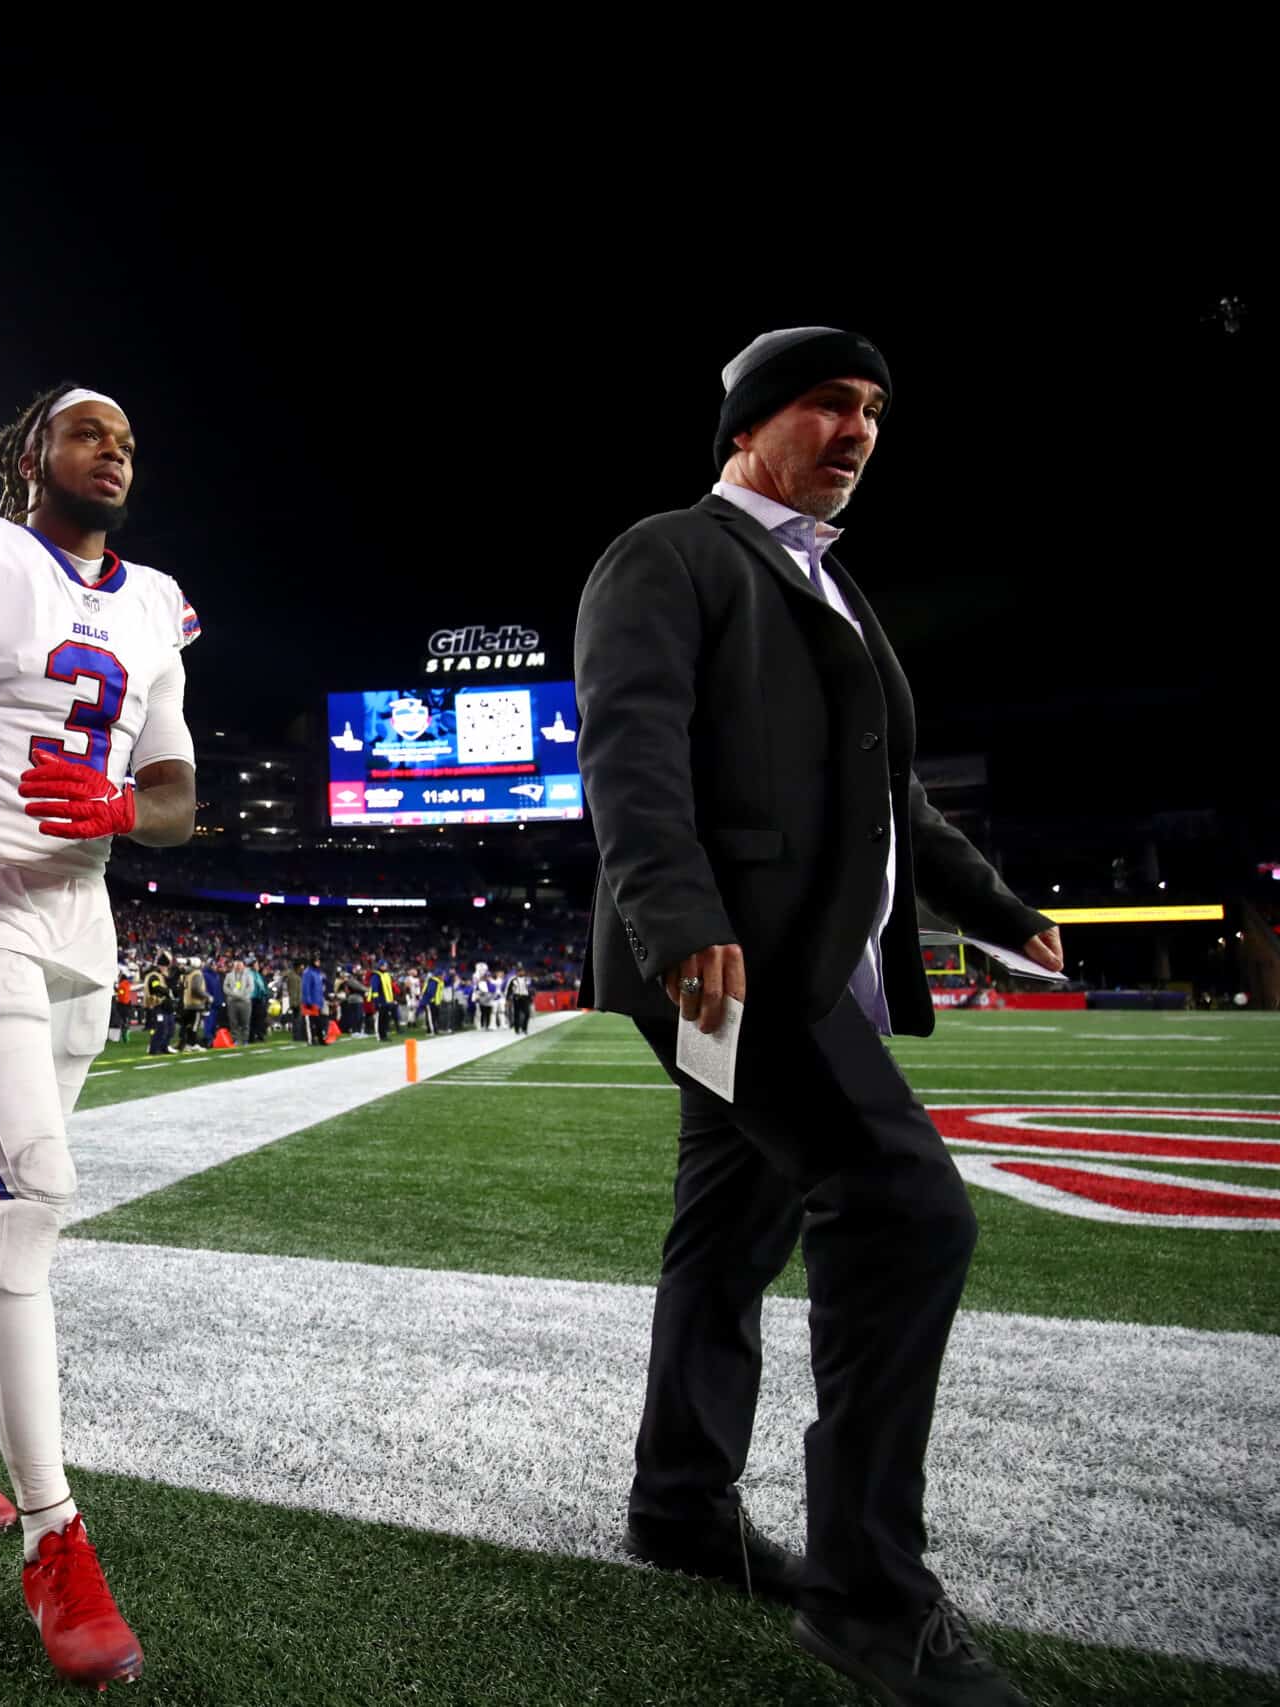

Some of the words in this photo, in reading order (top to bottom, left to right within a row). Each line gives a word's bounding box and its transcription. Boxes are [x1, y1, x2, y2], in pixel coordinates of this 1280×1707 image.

[72, 622, 109, 641] BILLS
[428, 625, 540, 656] Gillette
[426, 652, 545, 673] STADIUM
[29, 639, 128, 776] 3
[462, 789, 485, 802] PM
